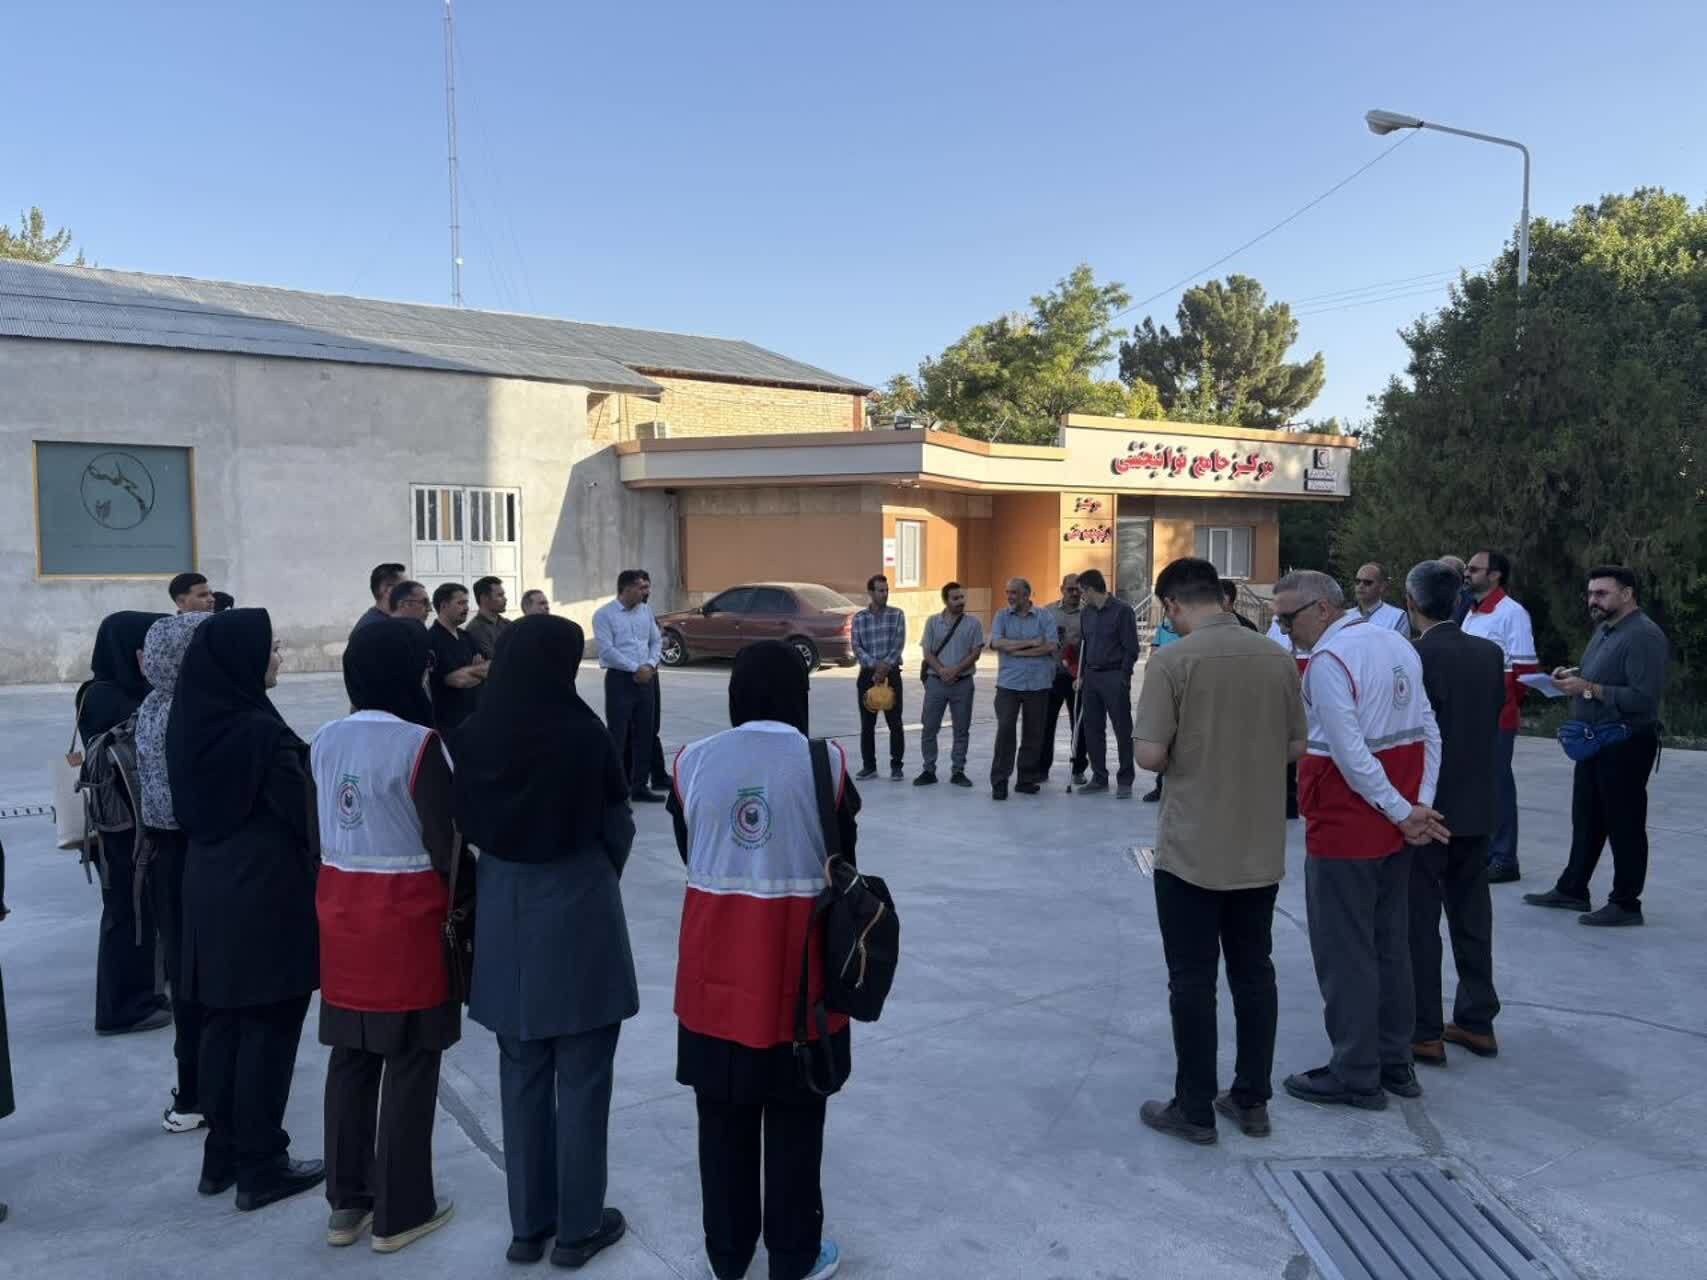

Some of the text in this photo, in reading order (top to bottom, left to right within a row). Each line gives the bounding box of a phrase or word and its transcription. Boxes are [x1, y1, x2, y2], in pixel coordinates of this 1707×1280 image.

[1111, 440, 1275, 481] مرکز جامع توانبخشی
